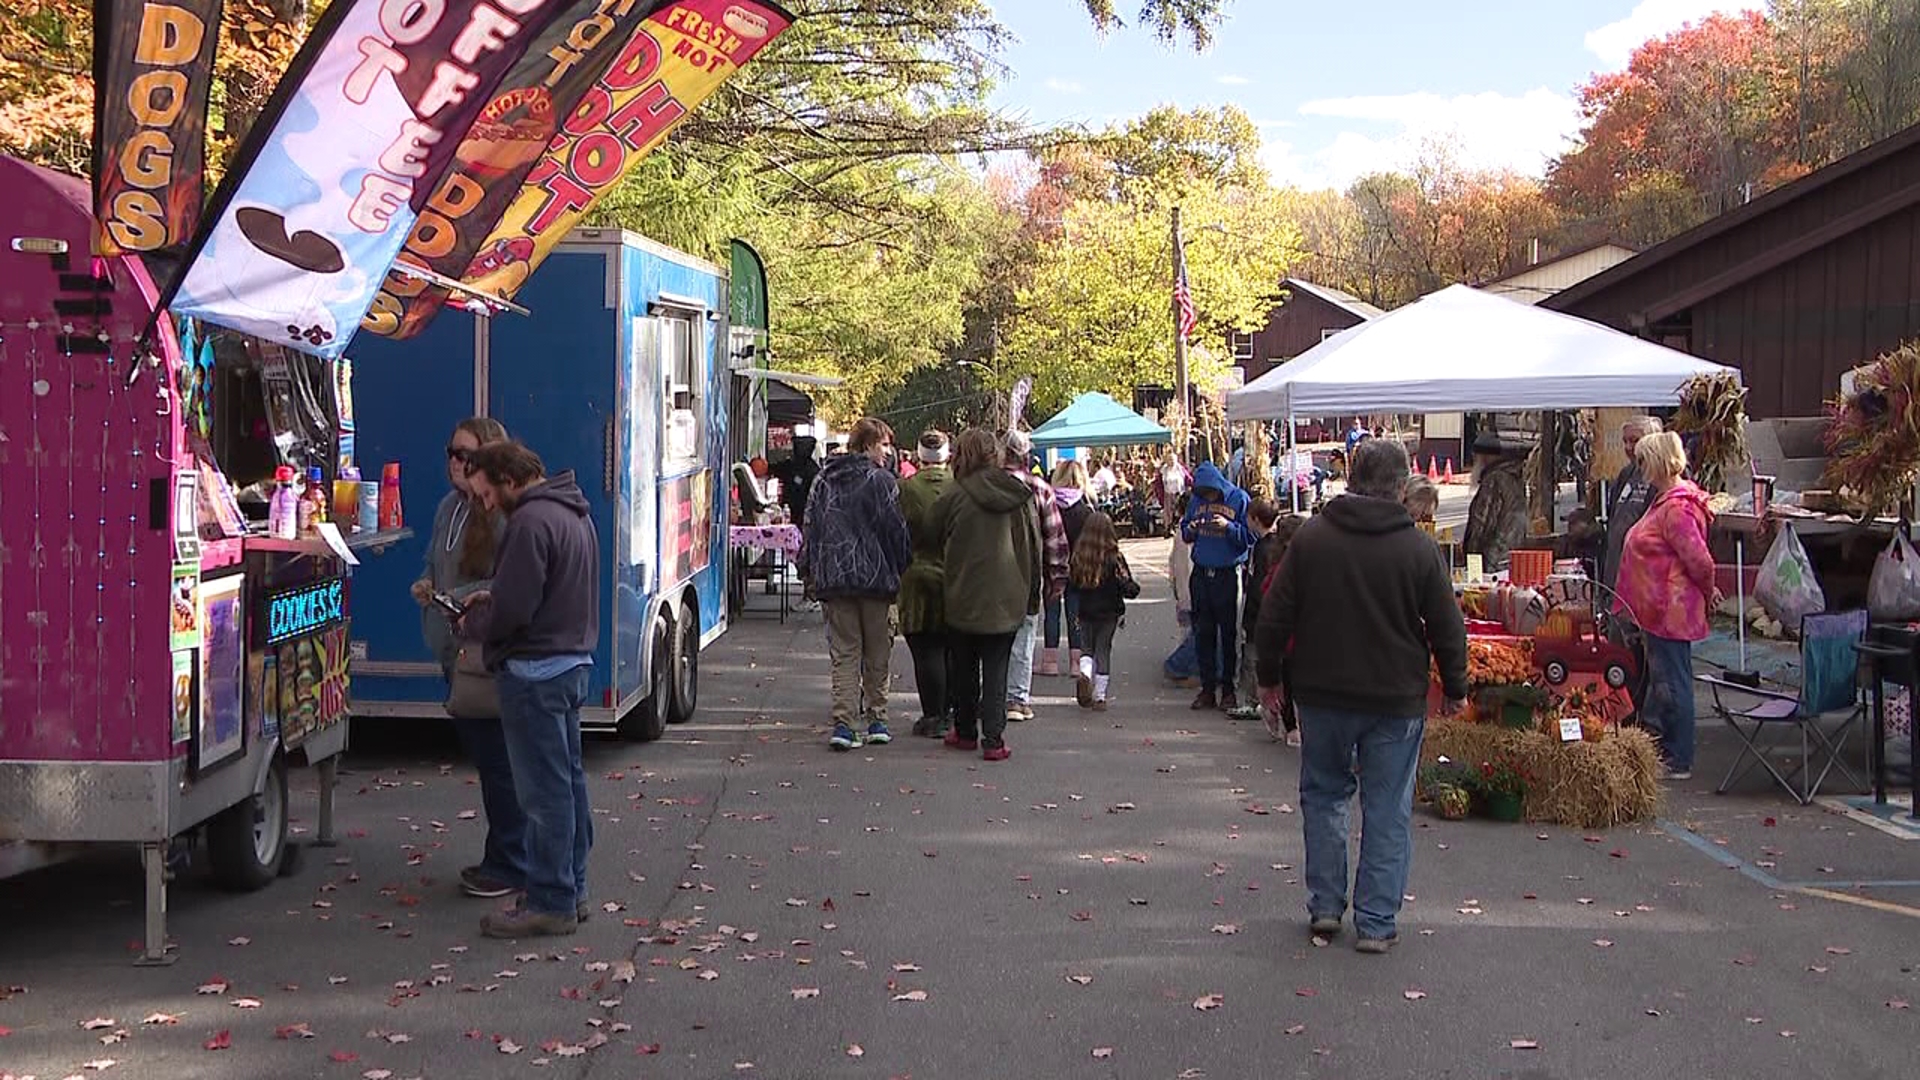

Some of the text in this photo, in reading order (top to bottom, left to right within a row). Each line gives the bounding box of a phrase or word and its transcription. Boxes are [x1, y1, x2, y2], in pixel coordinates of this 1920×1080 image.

[666, 6, 742, 54] FRESH
[672, 38, 727, 73] HOT
[107, 2, 205, 250] DOGS
[528, 79, 686, 235] HOT
[271, 588, 328, 637] COOKIES
